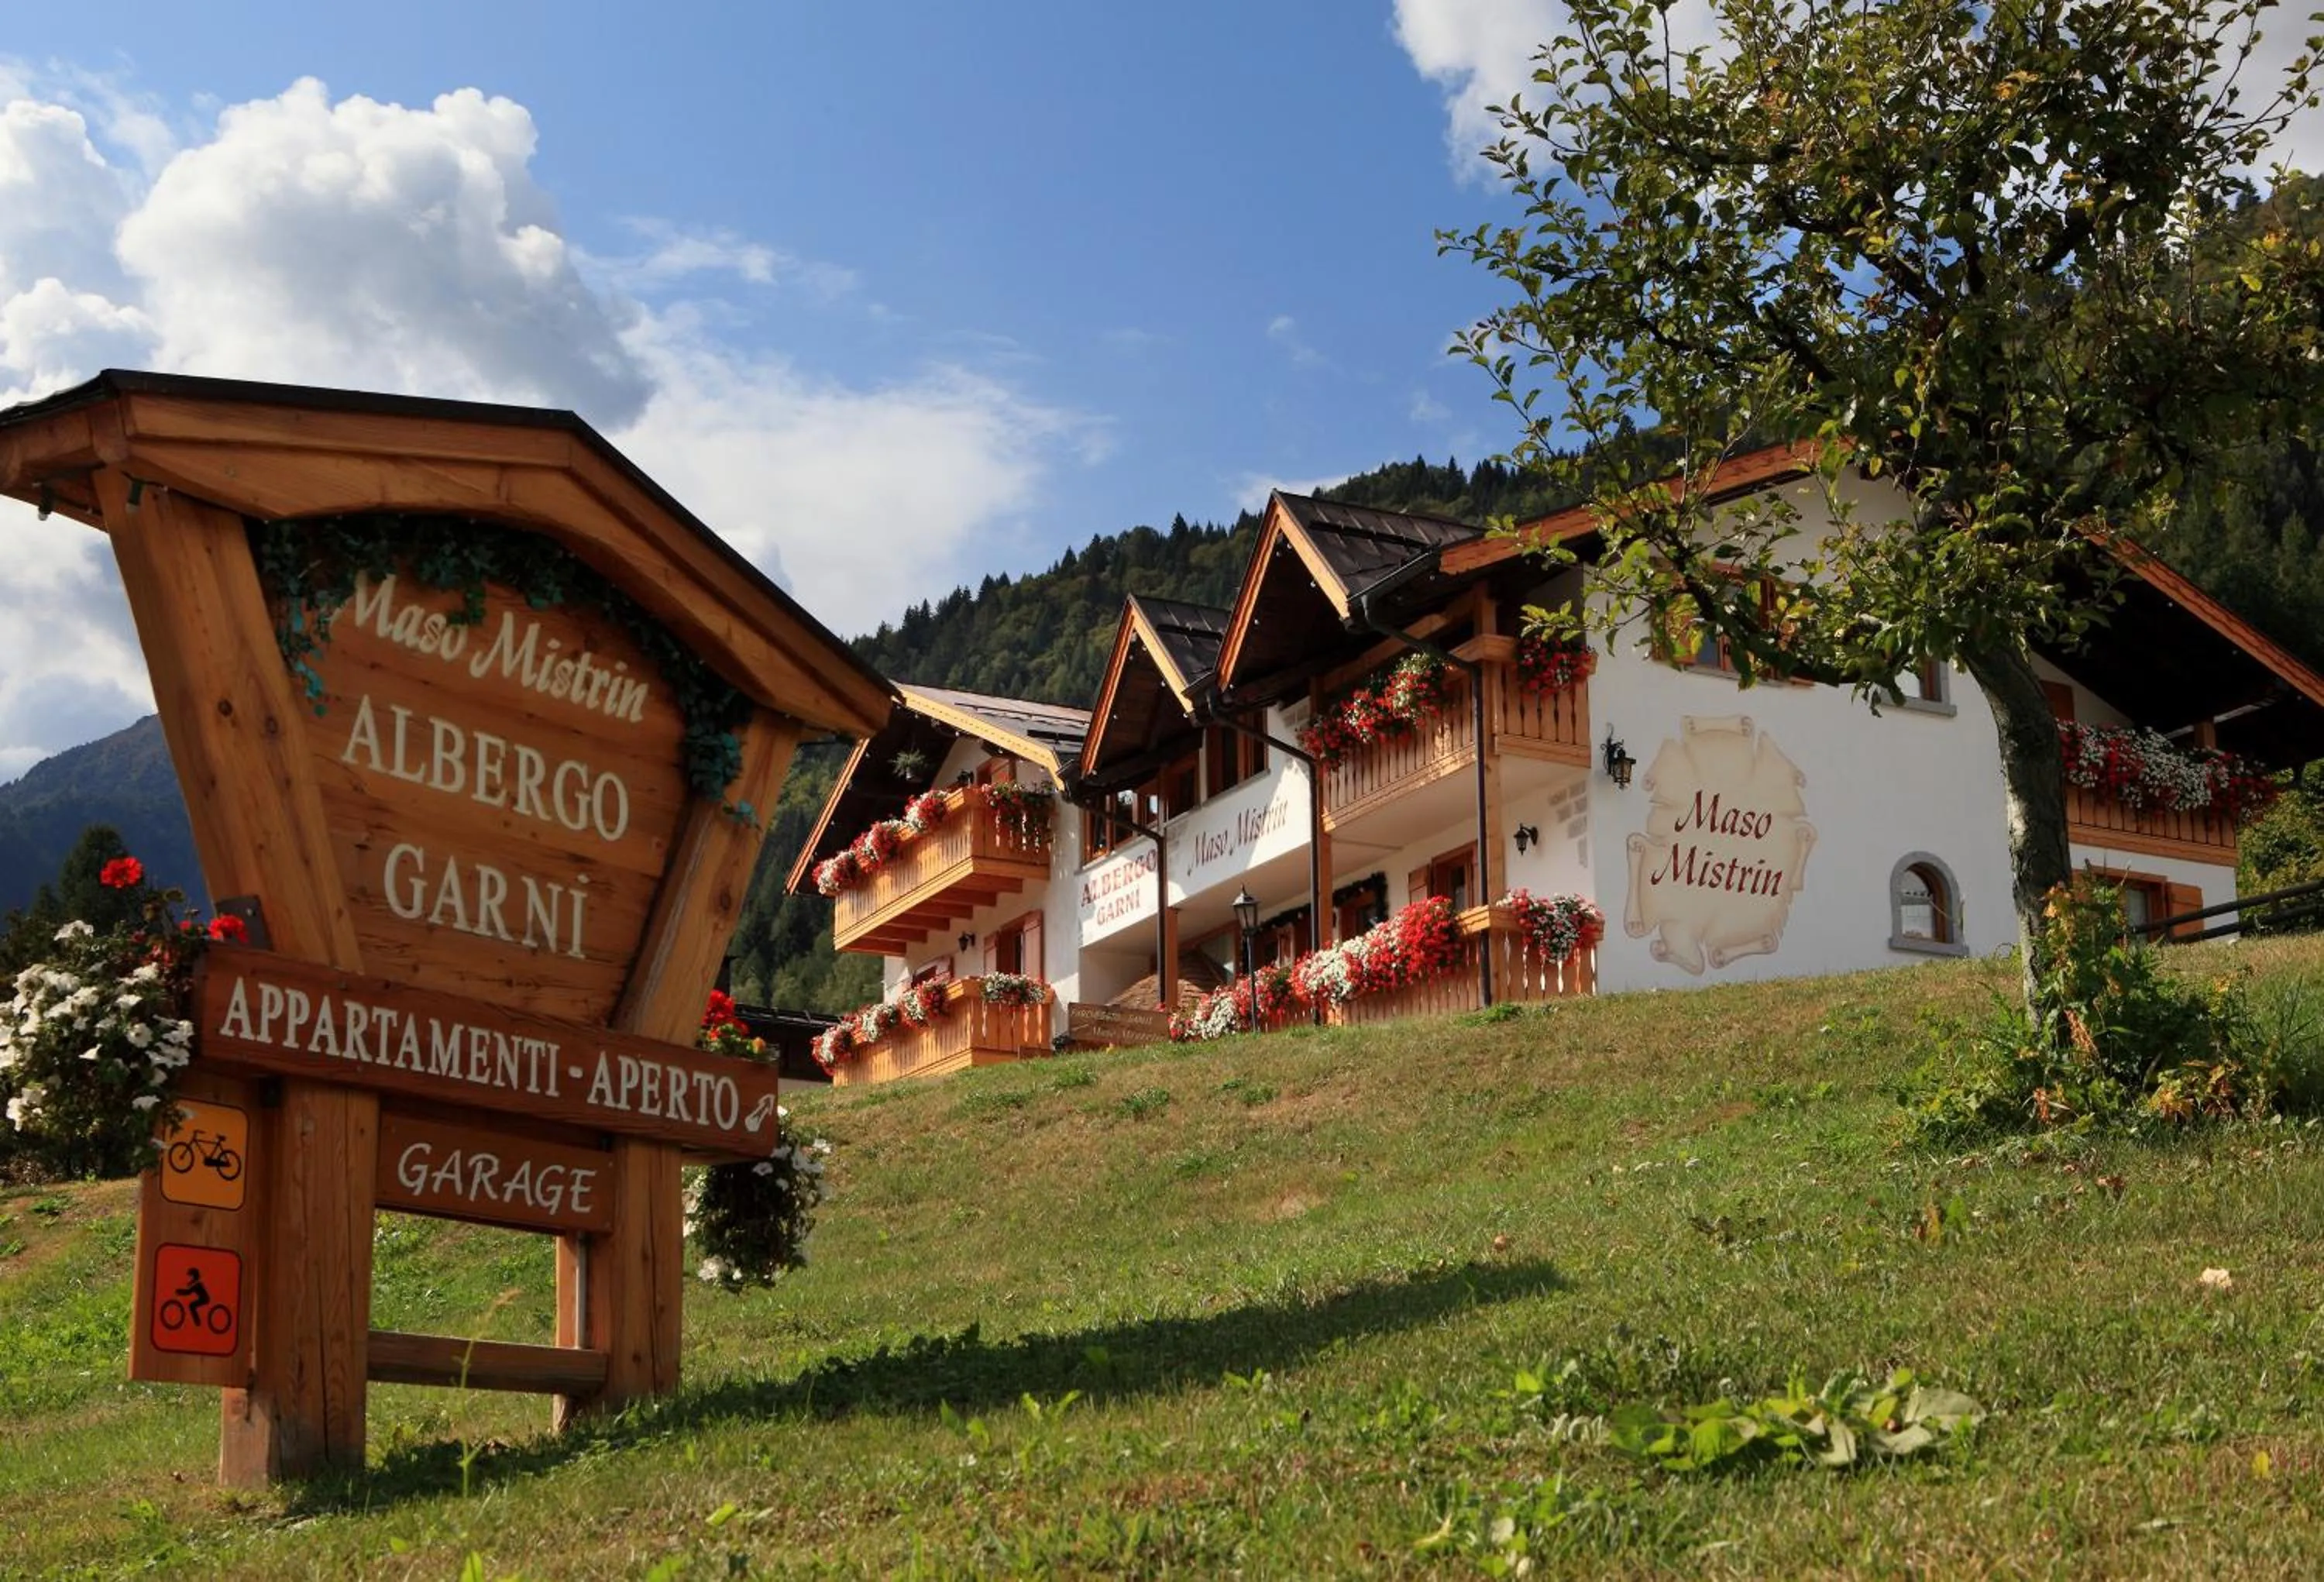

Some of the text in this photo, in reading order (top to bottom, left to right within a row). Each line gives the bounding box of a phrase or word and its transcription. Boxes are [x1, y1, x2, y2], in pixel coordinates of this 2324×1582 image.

[330, 569, 650, 723] Maso Mistrin
[341, 693, 630, 842] ALBERGO
[1187, 796, 1288, 877] Maso Mistrin
[1673, 789, 1772, 840] Maso
[1081, 848, 1157, 908] ALBERGO
[1650, 842, 1783, 897] Mistrin
[219, 976, 562, 1098] APPARTAMENTI
[586, 1051, 740, 1133] APERTO
[397, 1141, 598, 1216] GARAGE
